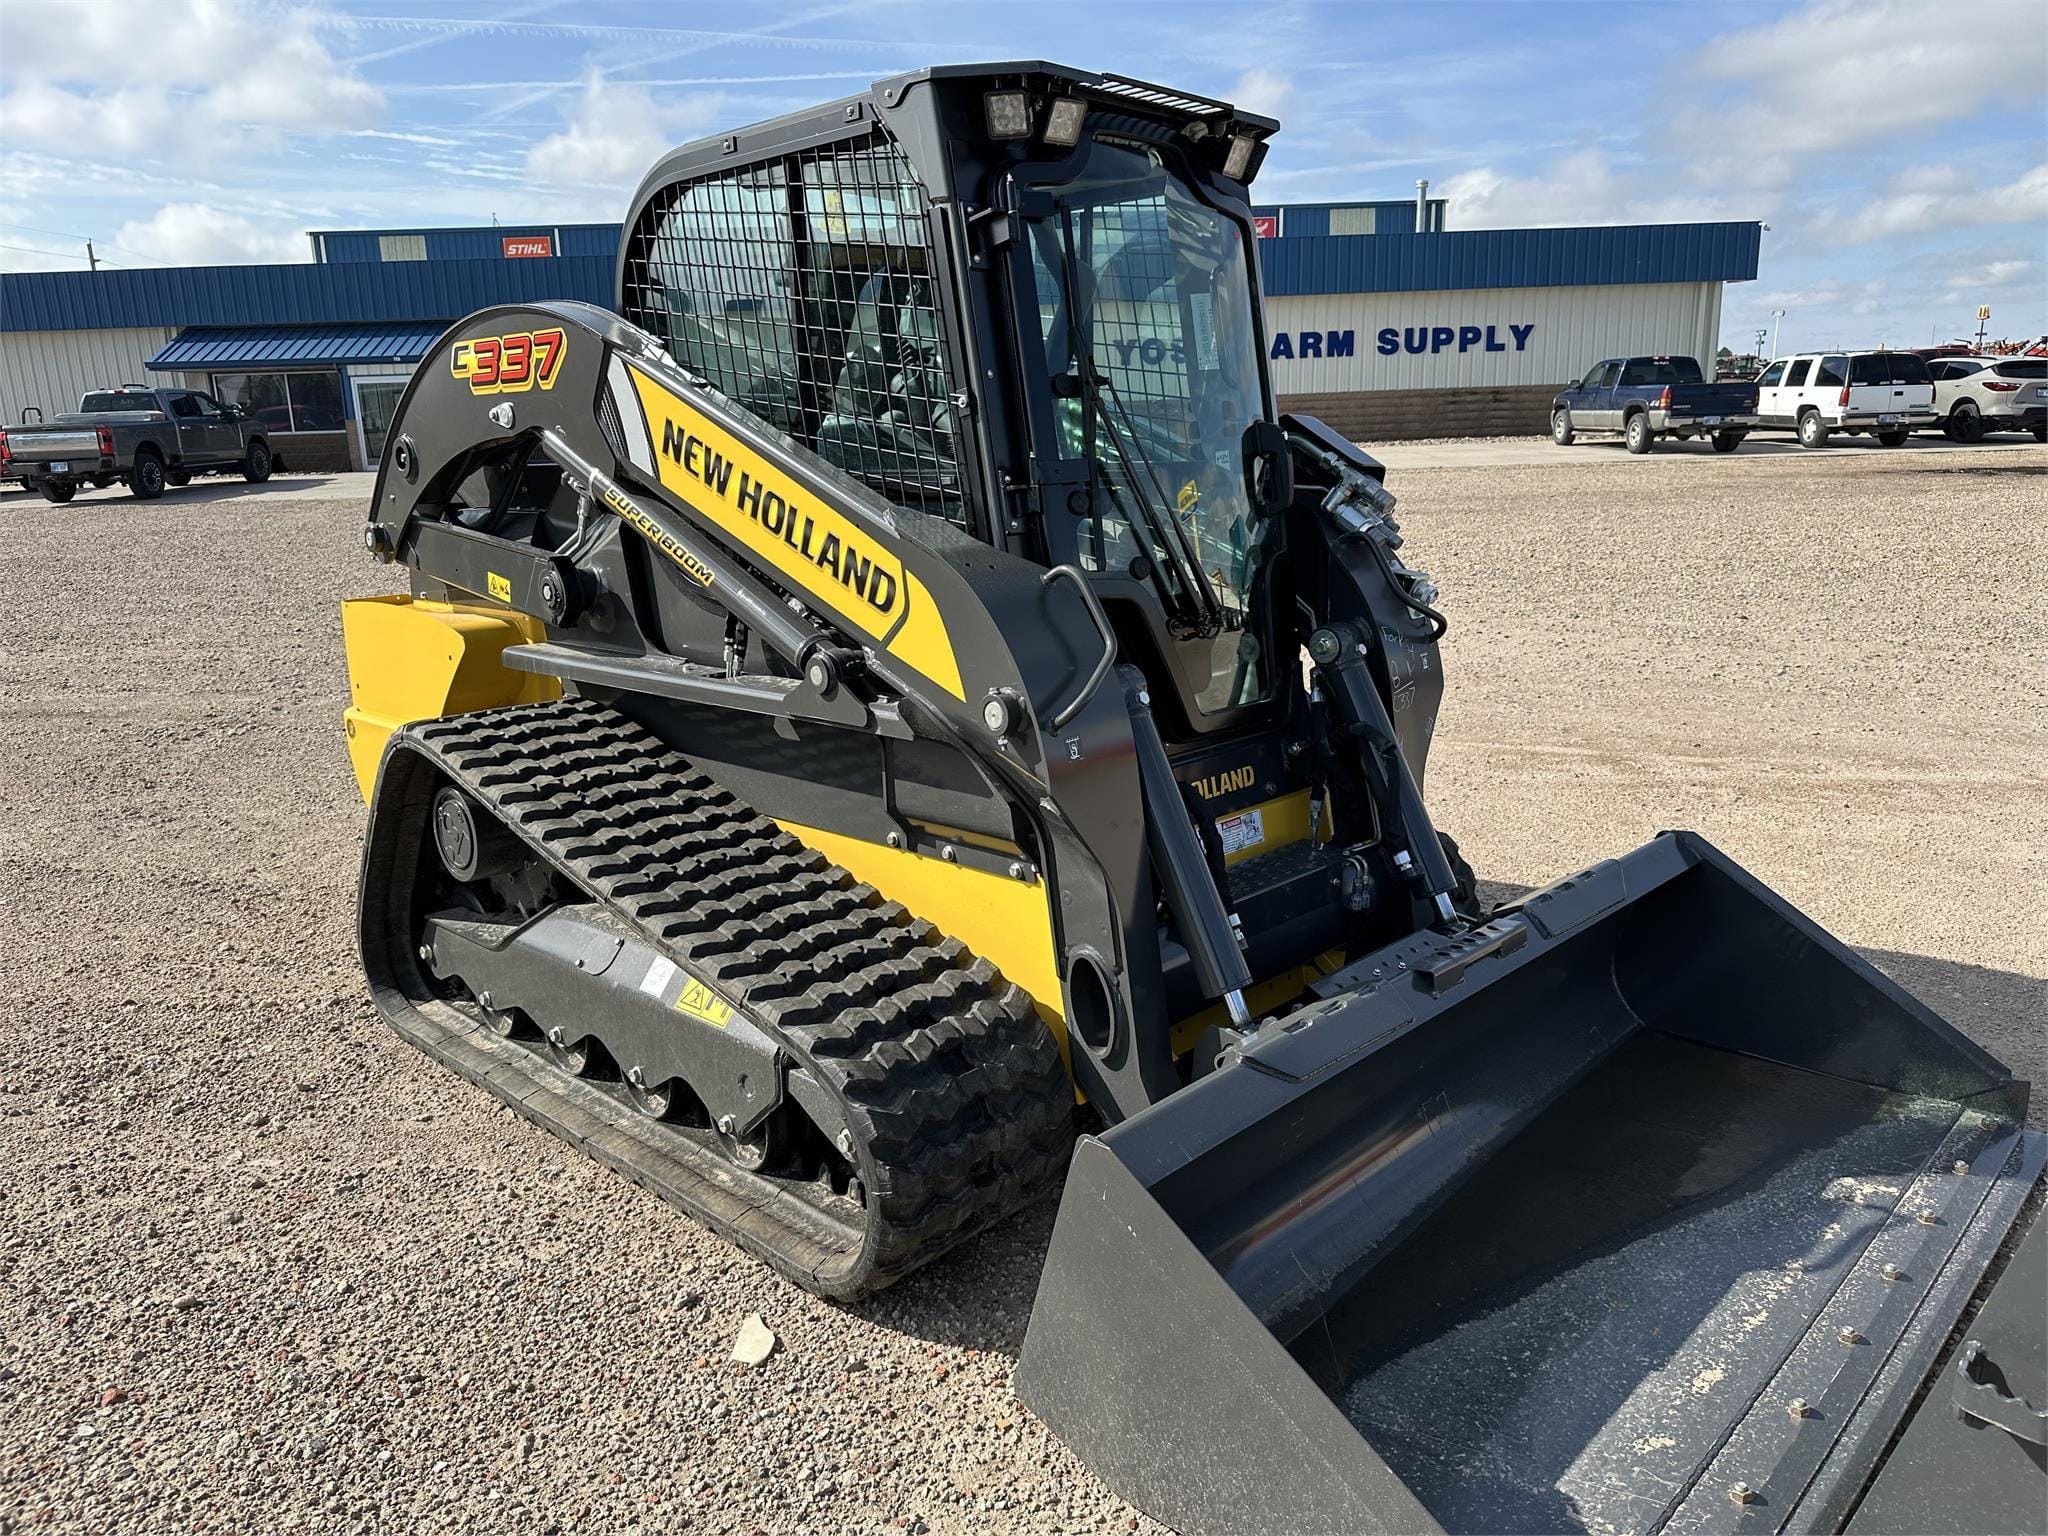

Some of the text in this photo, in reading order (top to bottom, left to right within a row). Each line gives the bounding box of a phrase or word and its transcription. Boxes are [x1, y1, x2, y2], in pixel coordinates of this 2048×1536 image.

[507, 243, 547, 255] STIHL
[452, 327, 567, 395] C337
[1113, 338, 1186, 366] YOS
[1270, 331, 1355, 360] ARM
[1377, 324, 1535, 356] SUPPLY
[661, 417, 898, 614] NEW HOLLAND
[1191, 765, 1255, 800] OLLAND
